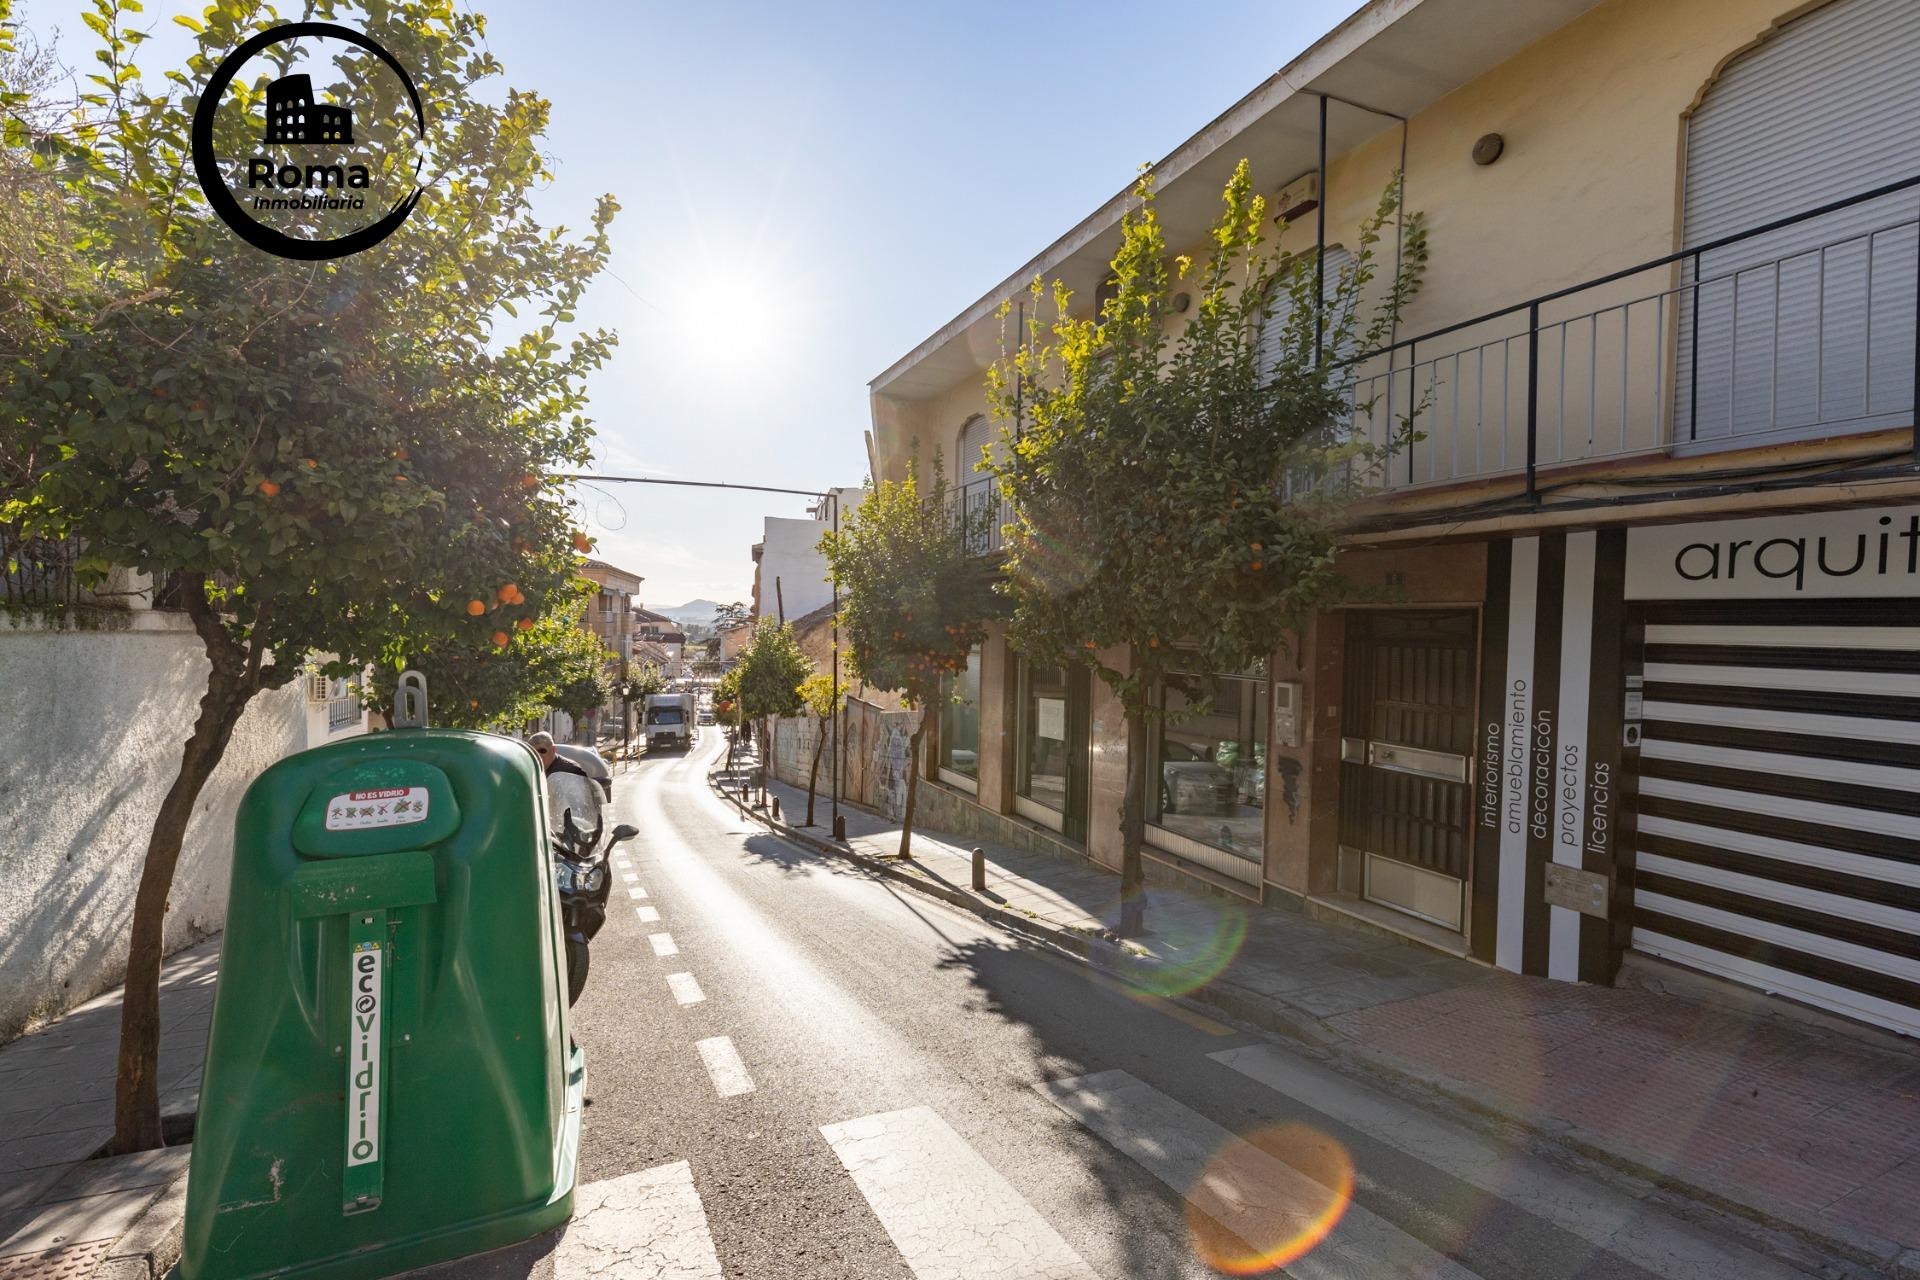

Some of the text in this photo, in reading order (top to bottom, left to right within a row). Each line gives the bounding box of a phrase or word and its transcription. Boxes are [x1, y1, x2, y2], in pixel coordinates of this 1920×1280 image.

[355, 789, 405, 801] NO ES VIDRIO
[1480, 722, 1500, 829] interiorismo
[1507, 679, 1527, 834] amueblamiento
[1530, 709, 1552, 840] decoracicón
[1560, 744, 1582, 848] proyectos
[1587, 762, 1610, 855] licencias
[351, 954, 377, 1161] ecovidrio
